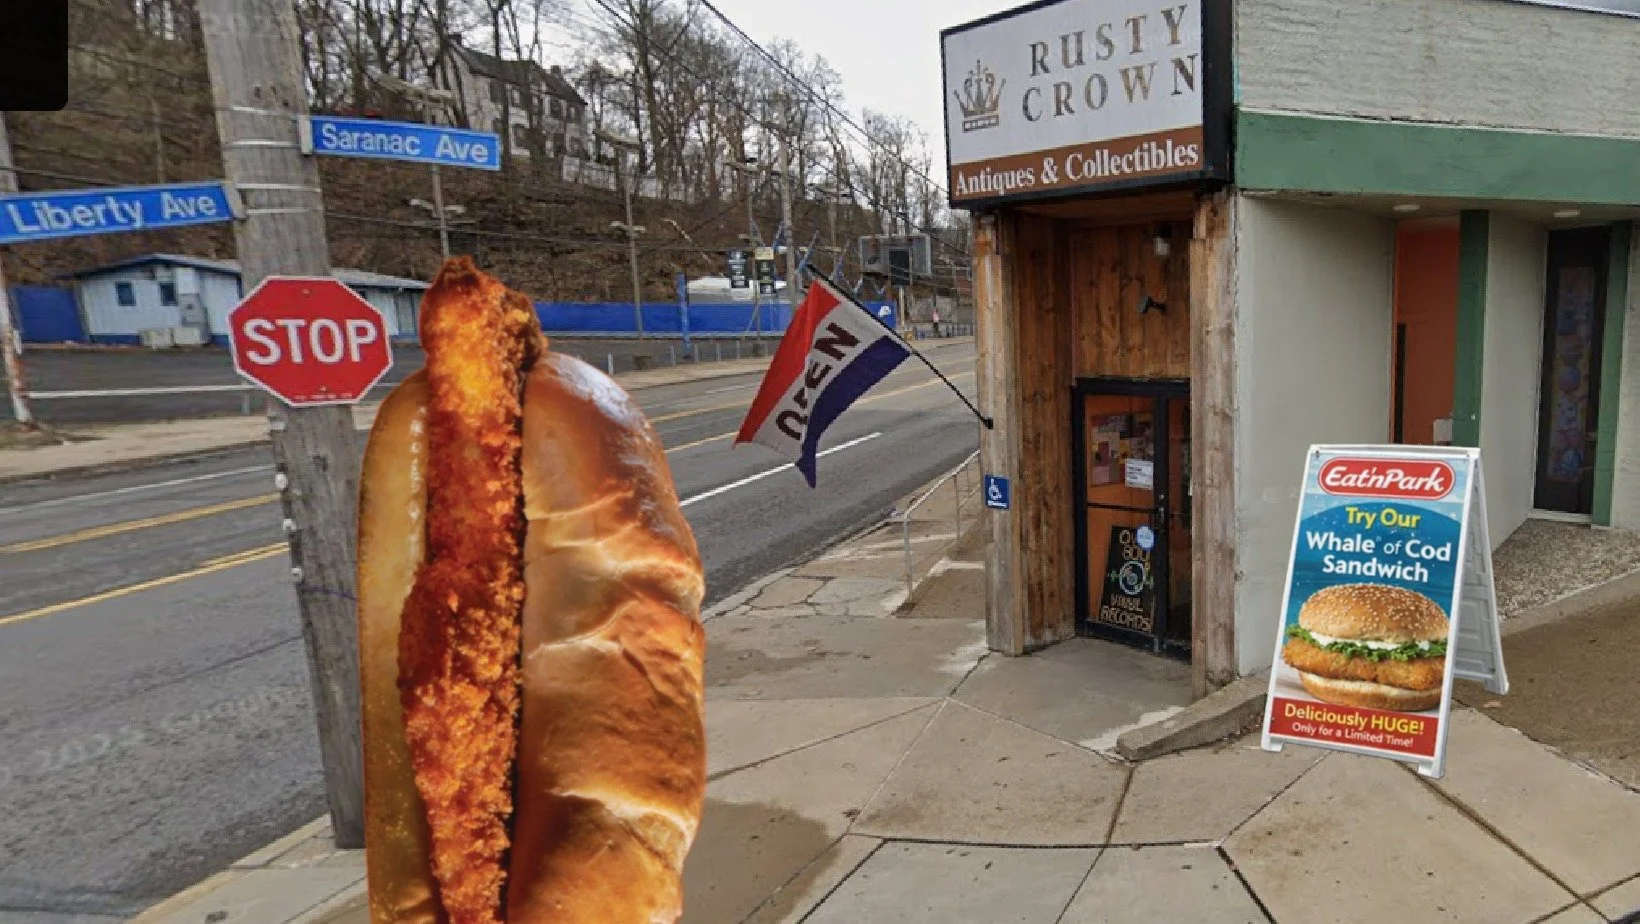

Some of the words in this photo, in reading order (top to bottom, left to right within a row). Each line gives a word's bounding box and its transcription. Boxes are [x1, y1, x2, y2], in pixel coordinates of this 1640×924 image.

[1029, 5, 1187, 77] RUSTY
[1022, 53, 1198, 121] CROWN
[322, 122, 420, 155] Saranac
[435, 132, 489, 163] Ave
[955, 166, 1035, 196] Antiques
[1040, 157, 1059, 184] &
[1064, 139, 1199, 181] Collectibles
[7, 197, 143, 233] Liberty
[161, 191, 217, 219] Ave
[243, 318, 378, 364] STOP
[1345, 506, 1375, 529] Try
[1381, 508, 1421, 528] Our
[1322, 555, 1429, 583] Sandwich
[1383, 539, 1402, 555] of
[1405, 539, 1452, 562] Cod
[1285, 702, 1367, 730] Deliciously
[1371, 714, 1424, 736] HUGE!
[1292, 722, 1316, 737] Only
[1318, 724, 1332, 738] for
[1334, 729, 1342, 738] a
[1344, 727, 1383, 745] Limited
[1386, 733, 1414, 748] Time!
